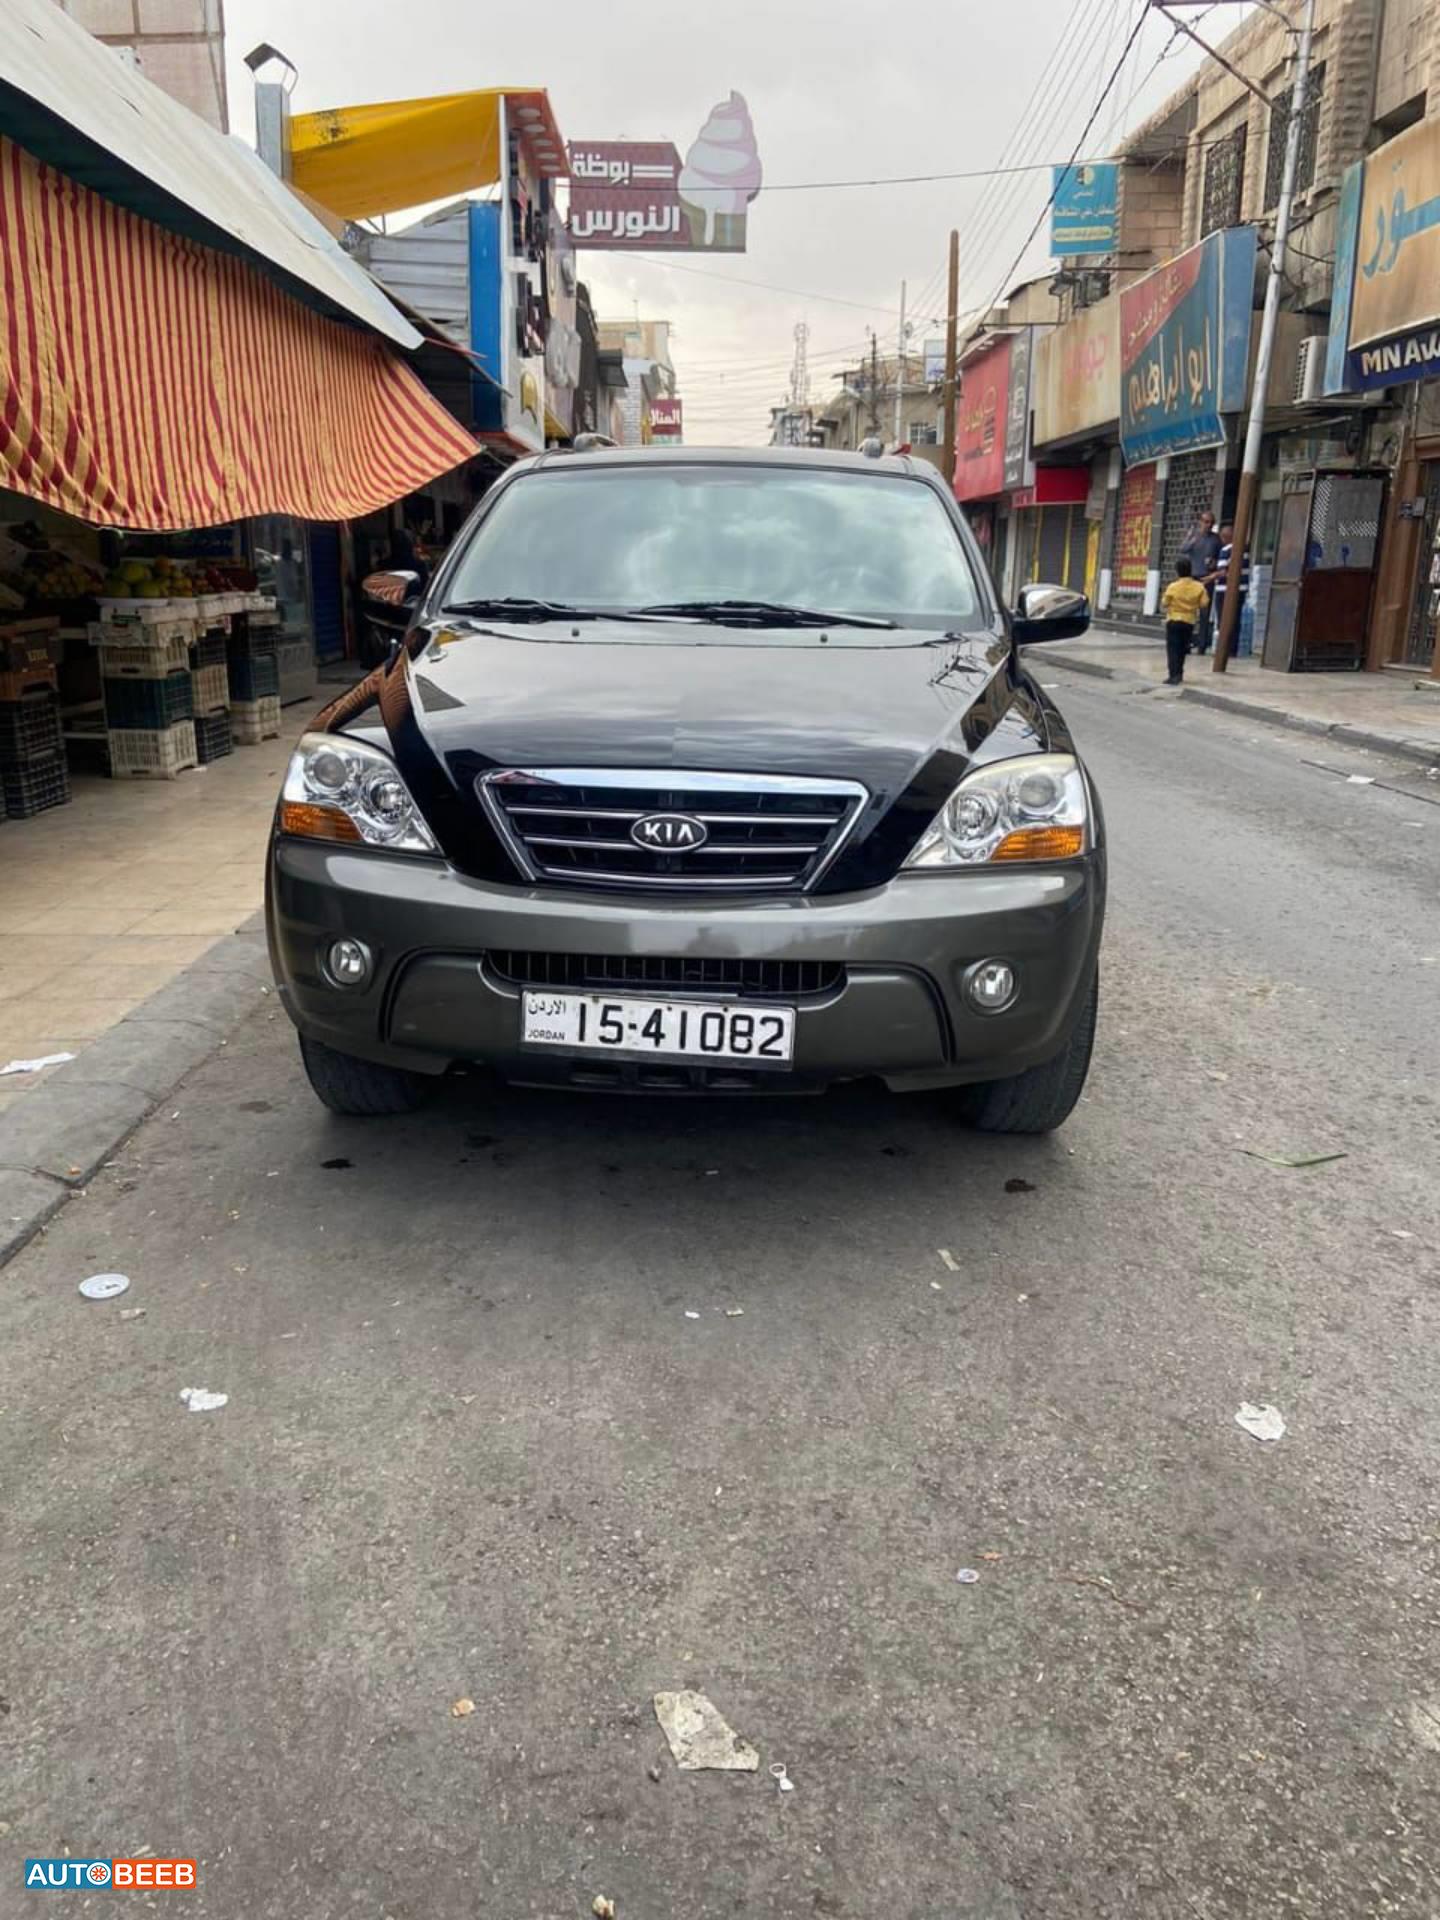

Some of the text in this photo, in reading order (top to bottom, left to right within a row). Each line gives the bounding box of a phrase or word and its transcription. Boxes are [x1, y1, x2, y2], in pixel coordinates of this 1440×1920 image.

[572, 152, 630, 184] بوظة
[571, 205, 681, 238] النورس
[644, 822, 695, 843] KIA
[527, 1029, 566, 1041] JORDAN
